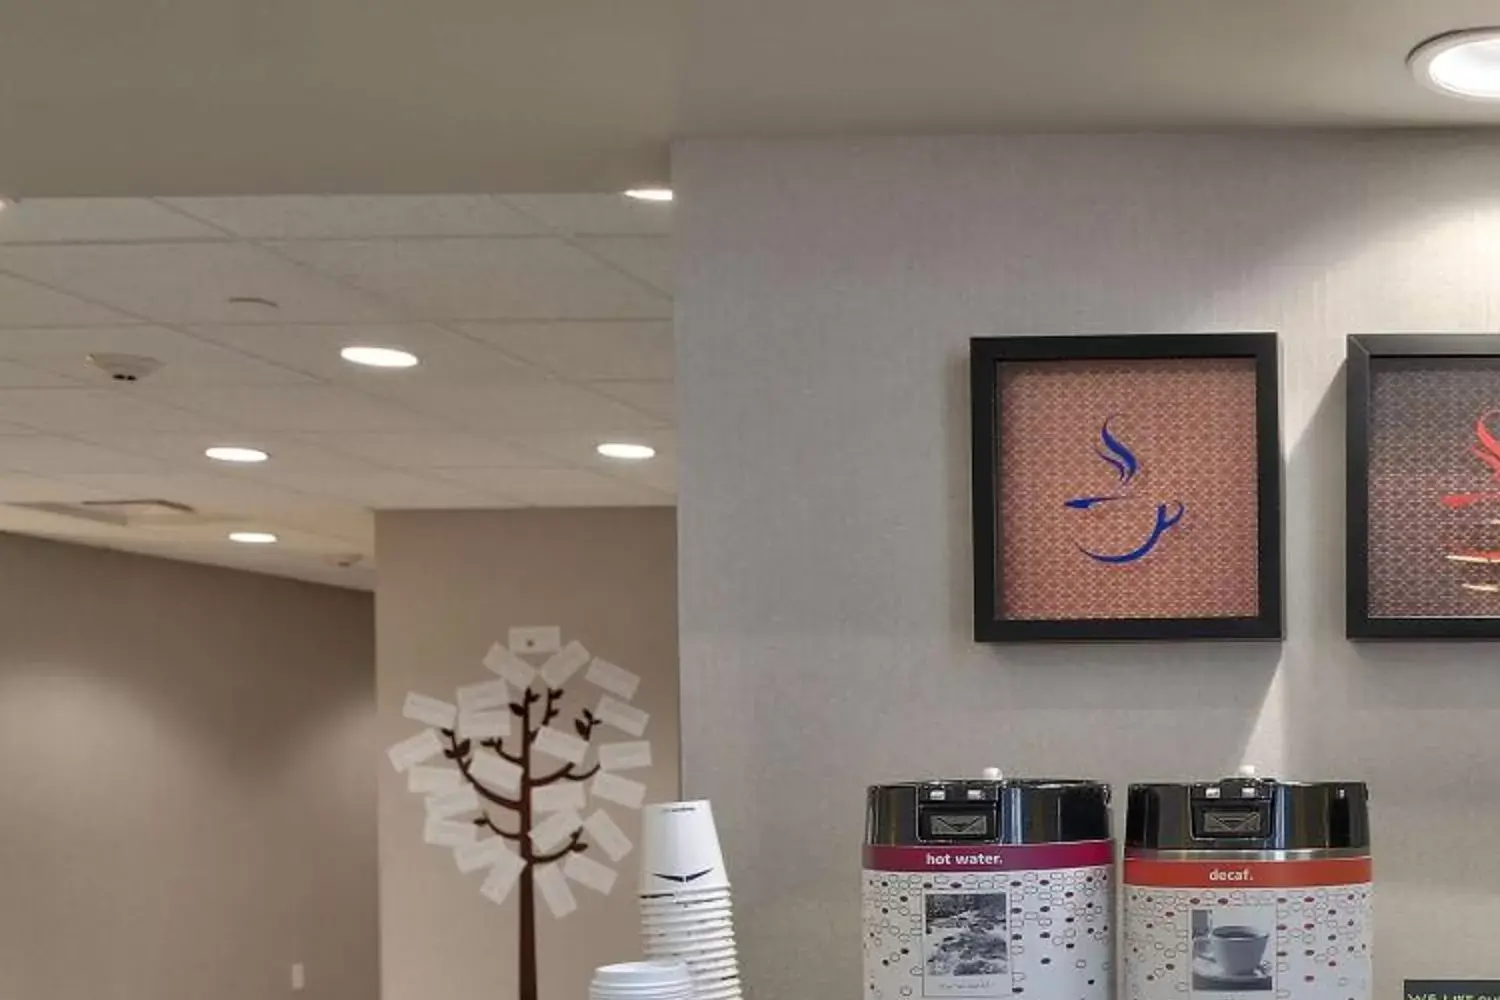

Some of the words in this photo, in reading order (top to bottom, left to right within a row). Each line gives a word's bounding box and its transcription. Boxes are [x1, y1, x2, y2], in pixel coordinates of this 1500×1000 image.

[926, 853, 951, 865] hot
[955, 853, 1003, 865] water.
[1209, 868, 1254, 881] decaf.
